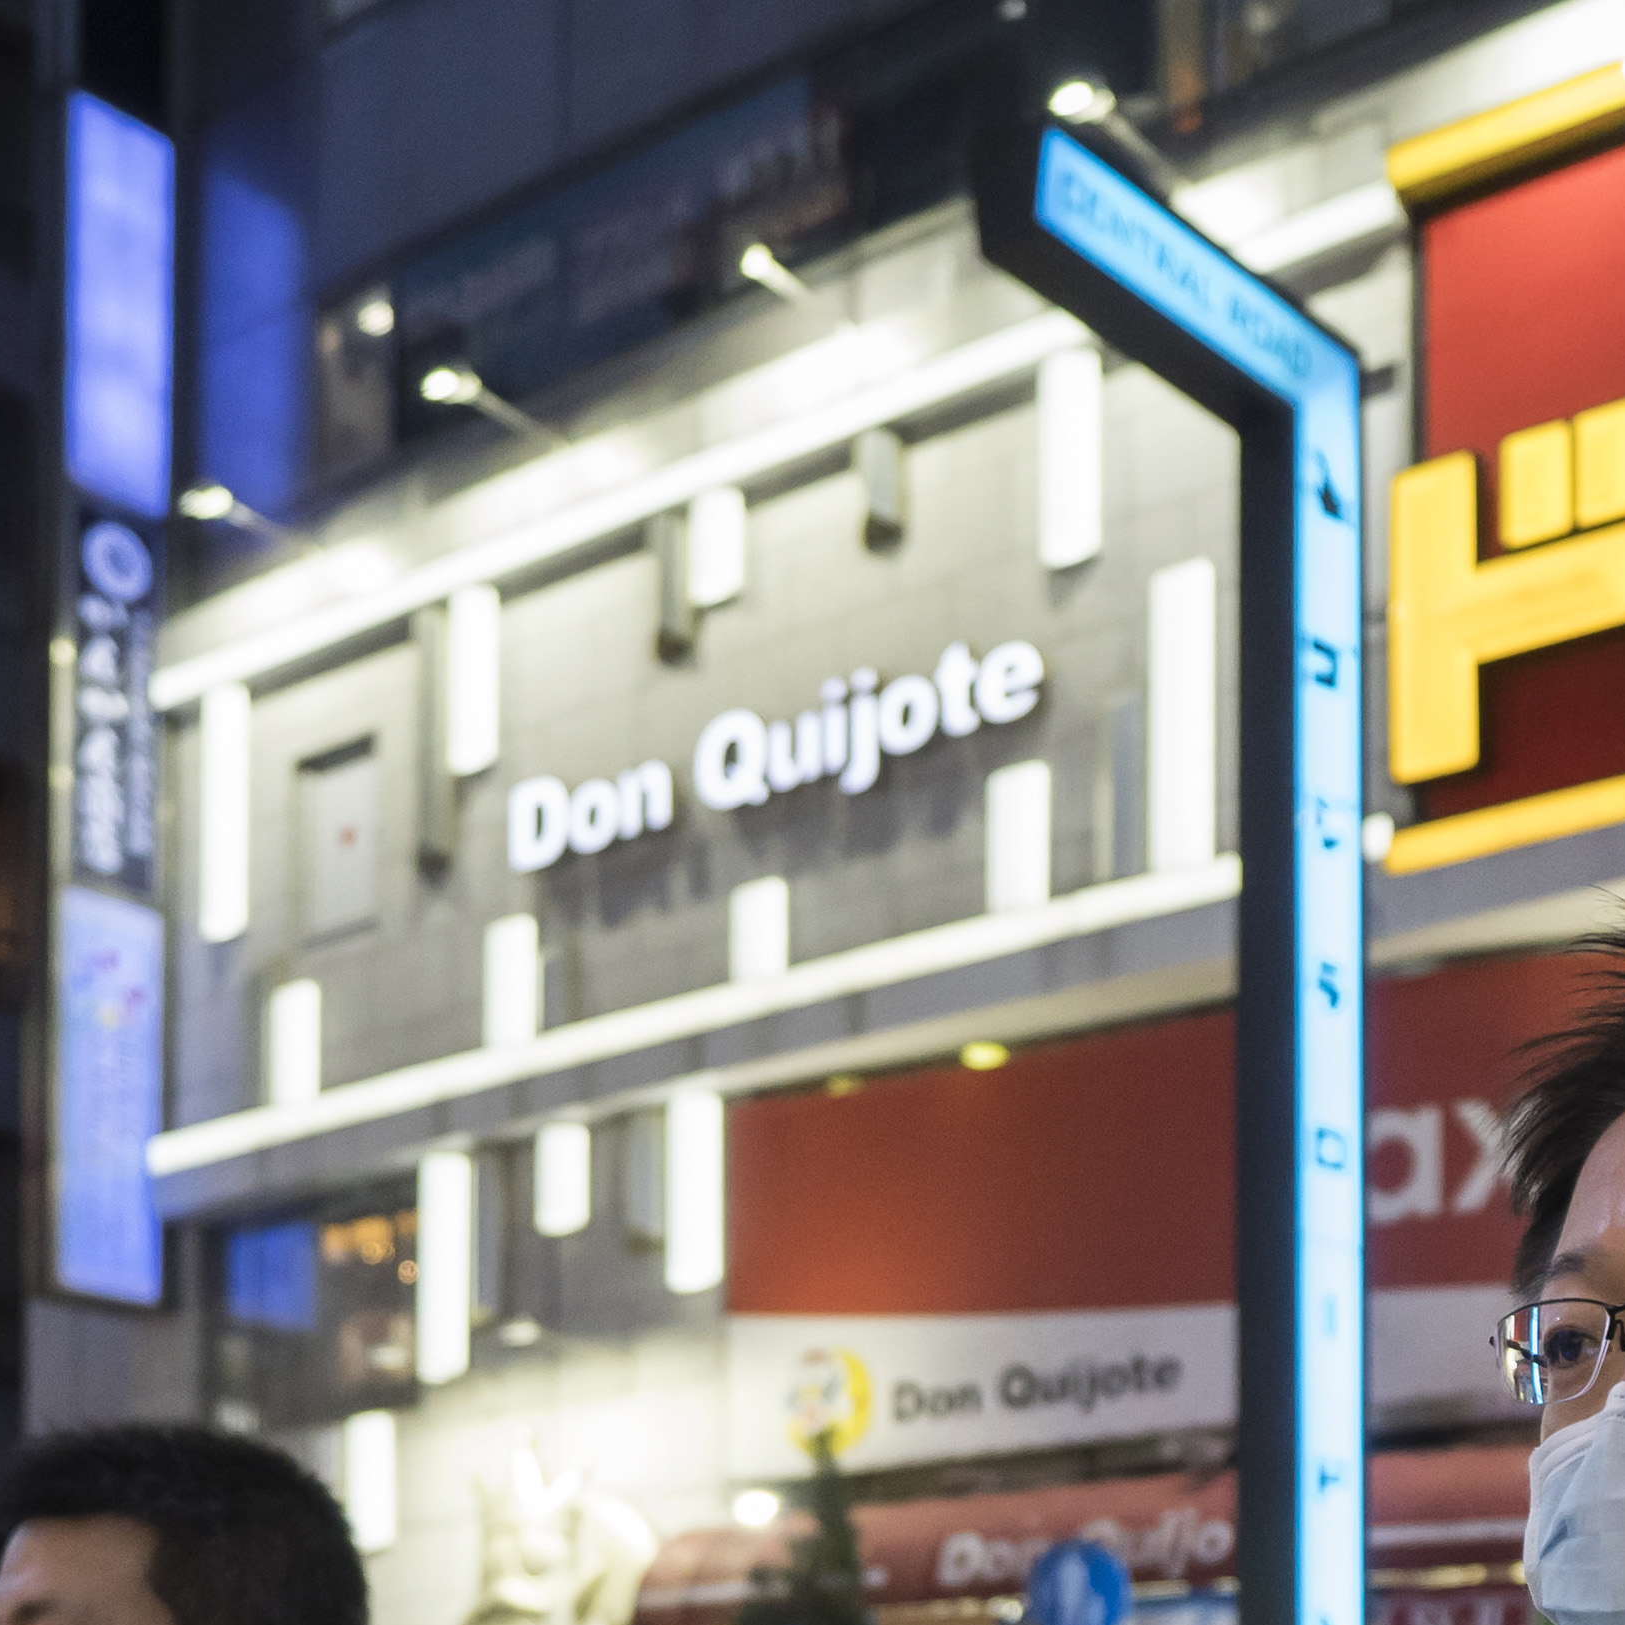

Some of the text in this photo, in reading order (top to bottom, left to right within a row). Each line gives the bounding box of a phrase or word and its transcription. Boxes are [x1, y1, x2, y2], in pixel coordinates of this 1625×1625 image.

[506, 636, 1046, 875] Don Quijote
[1364, 1097, 1538, 1227] ax
[891, 1353, 1181, 1424] Don Quijote
